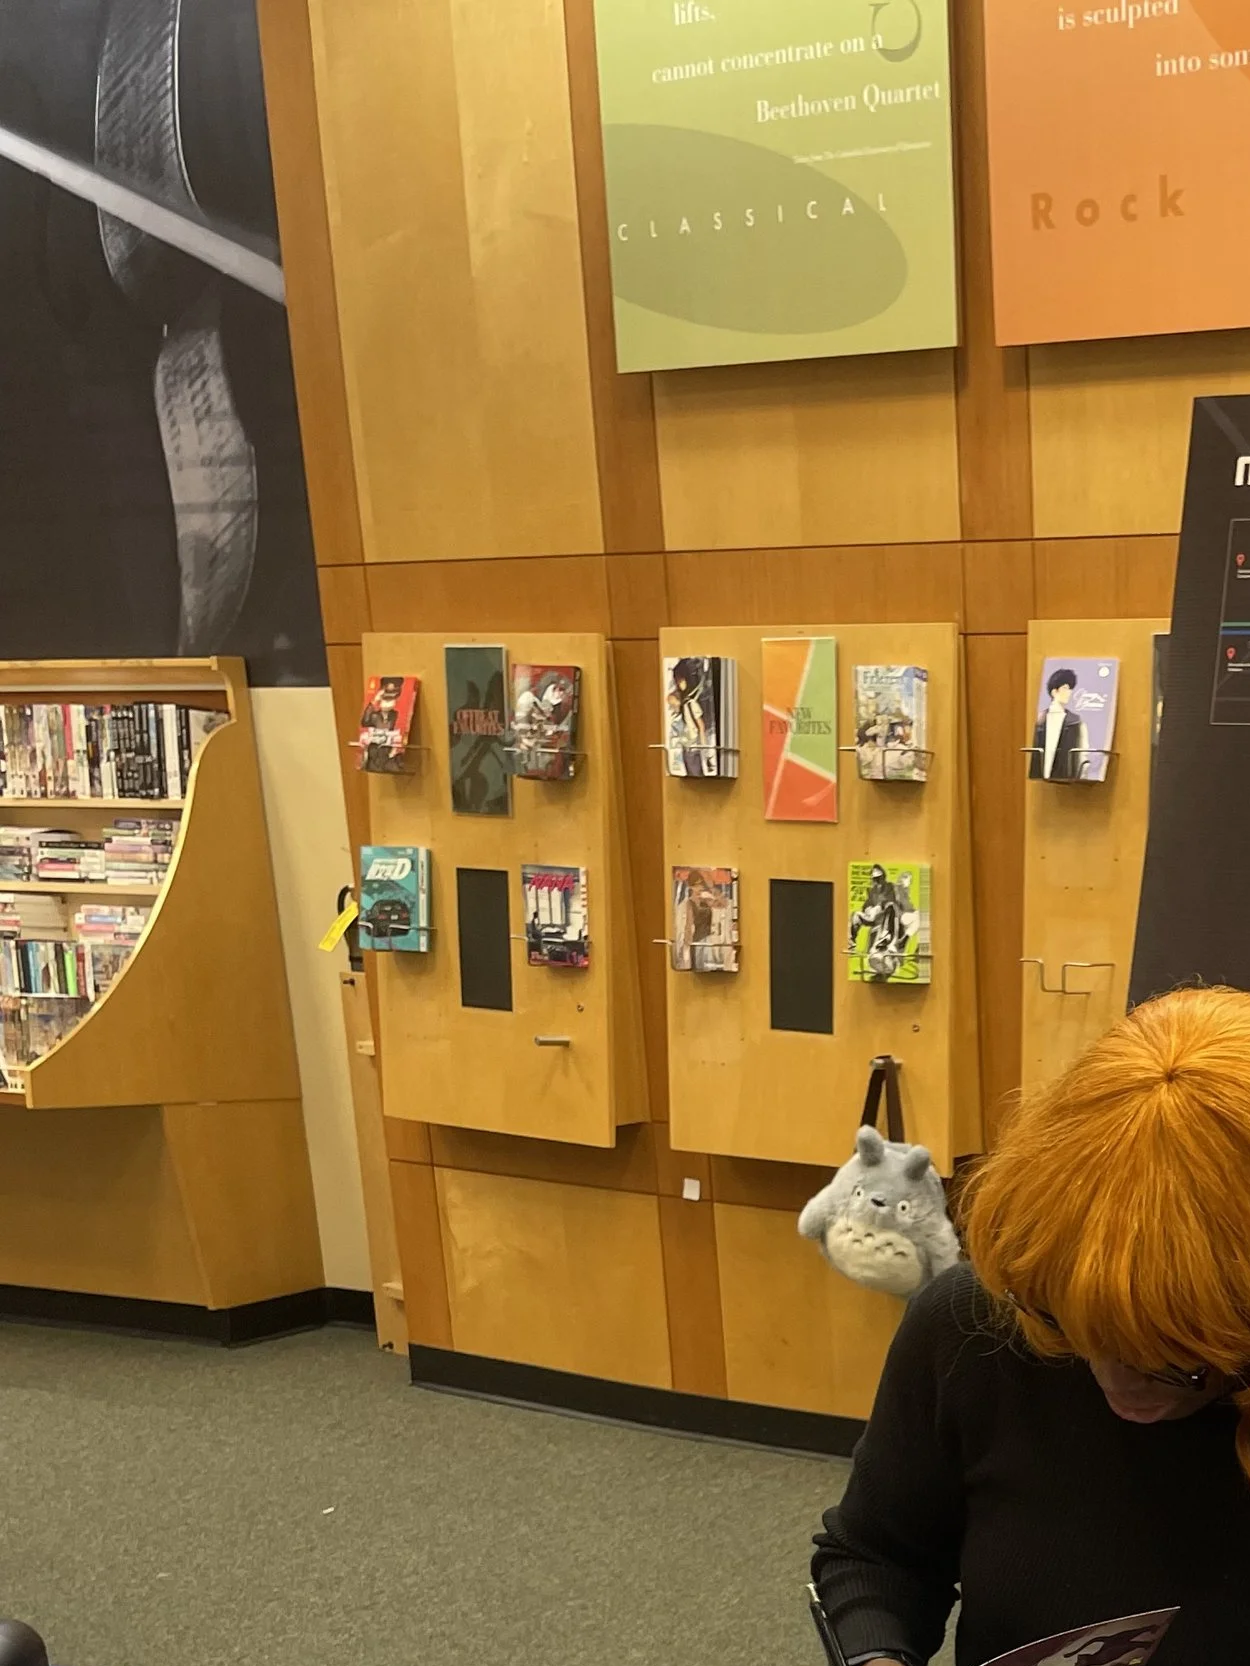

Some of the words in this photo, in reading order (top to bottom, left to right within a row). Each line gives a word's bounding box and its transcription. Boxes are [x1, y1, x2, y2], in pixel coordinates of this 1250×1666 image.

[673, 0, 716, 25] lifts.
[1059, 7, 1075, 30] is
[1082, 0, 1178, 28] sculpted
[652, 56, 714, 83] cannot
[722, 42, 833, 72] concentrate
[840, 36, 864, 55] on
[872, 34, 883, 50] a
[1155, 54, 1201, 76] into
[757, 94, 856, 122] Beethoven
[863, 82, 940, 112] Quartet
[617, 193, 886, 241] CLASSICAL
[1030, 174, 1185, 230] Rock
[769, 720, 831, 734] FAVORITES
